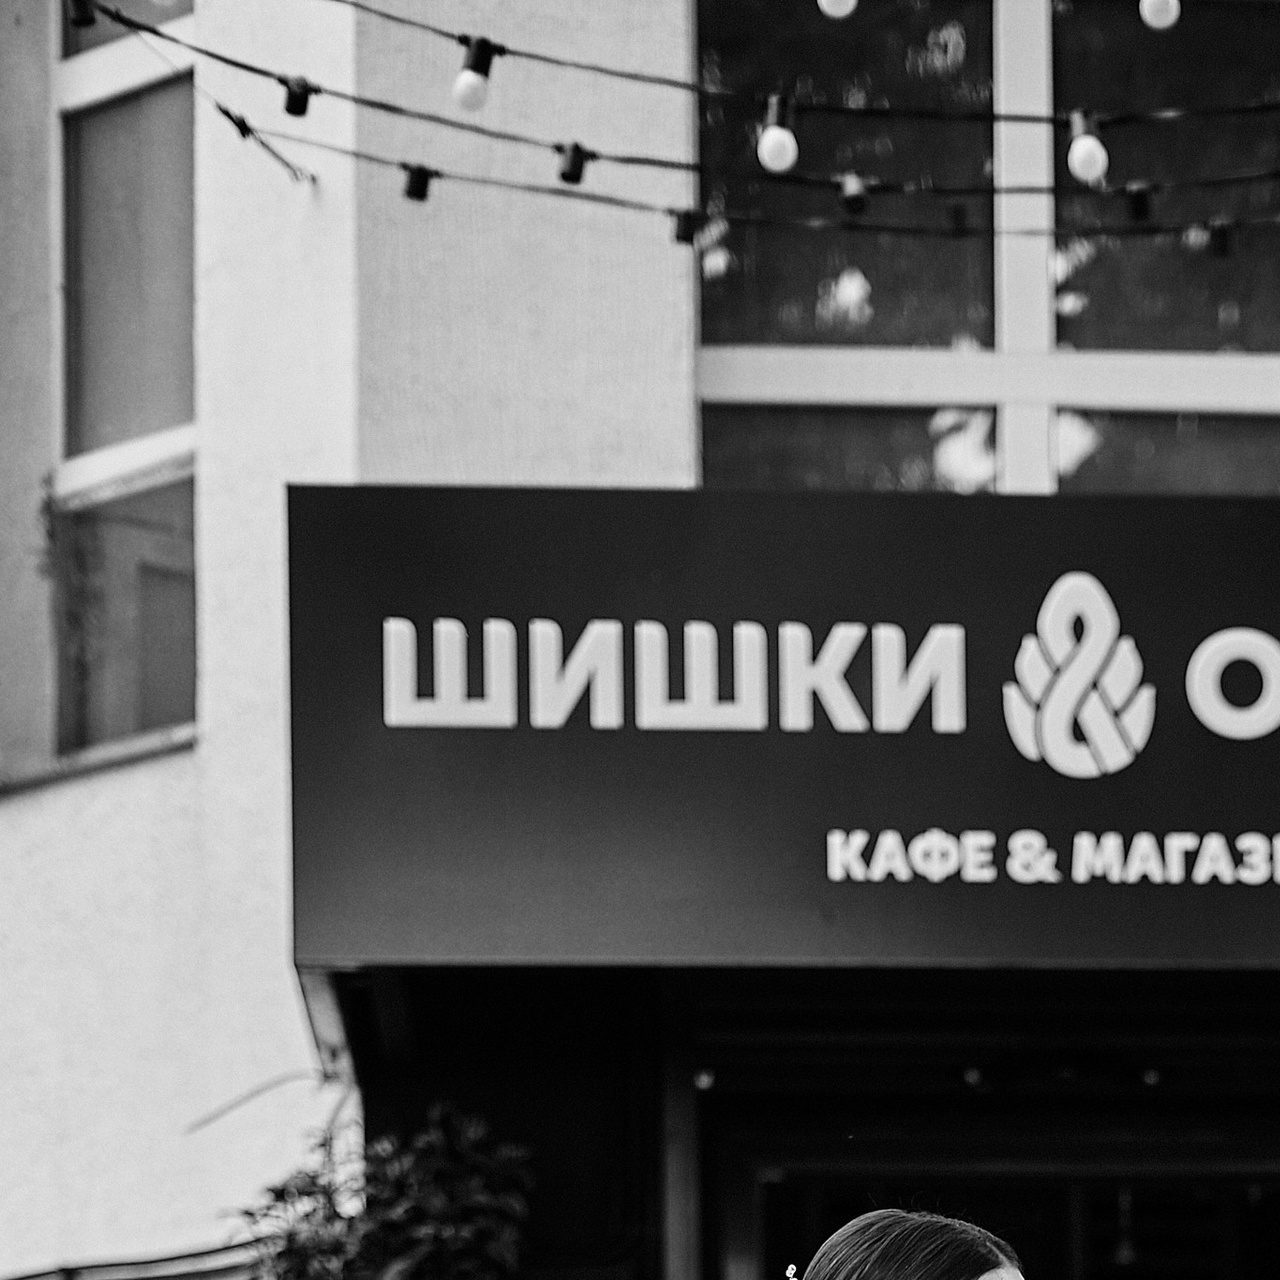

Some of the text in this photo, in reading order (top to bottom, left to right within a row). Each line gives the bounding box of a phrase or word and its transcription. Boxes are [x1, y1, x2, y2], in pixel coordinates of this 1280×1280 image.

[383, 617, 967, 733] ШИШКИ
[827, 829, 997, 882] КАФЕ
[1006, 829, 1060, 884] &
